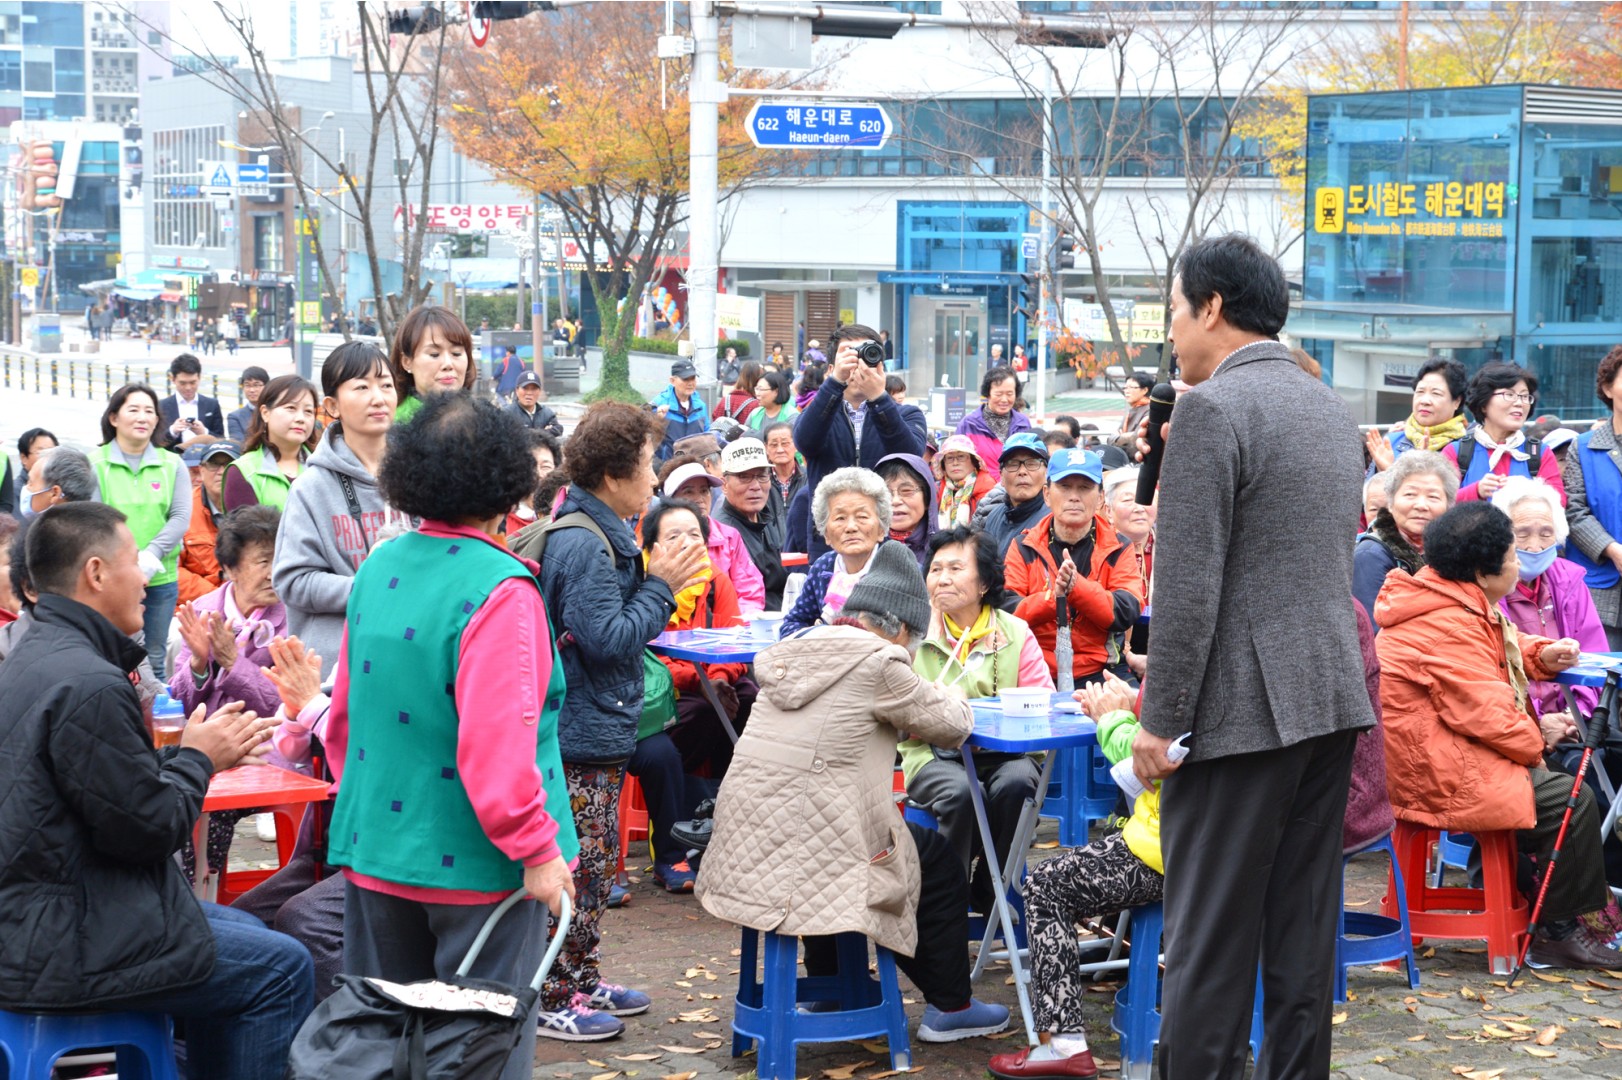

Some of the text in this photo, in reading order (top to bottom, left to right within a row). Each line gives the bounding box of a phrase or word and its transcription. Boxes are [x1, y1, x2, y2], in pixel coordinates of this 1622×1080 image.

[758, 108, 881, 132] 622 해운대로 620
[789, 131, 850, 143] Haeun-daero
[1346, 181, 1504, 217] 도시철도 해운대역
